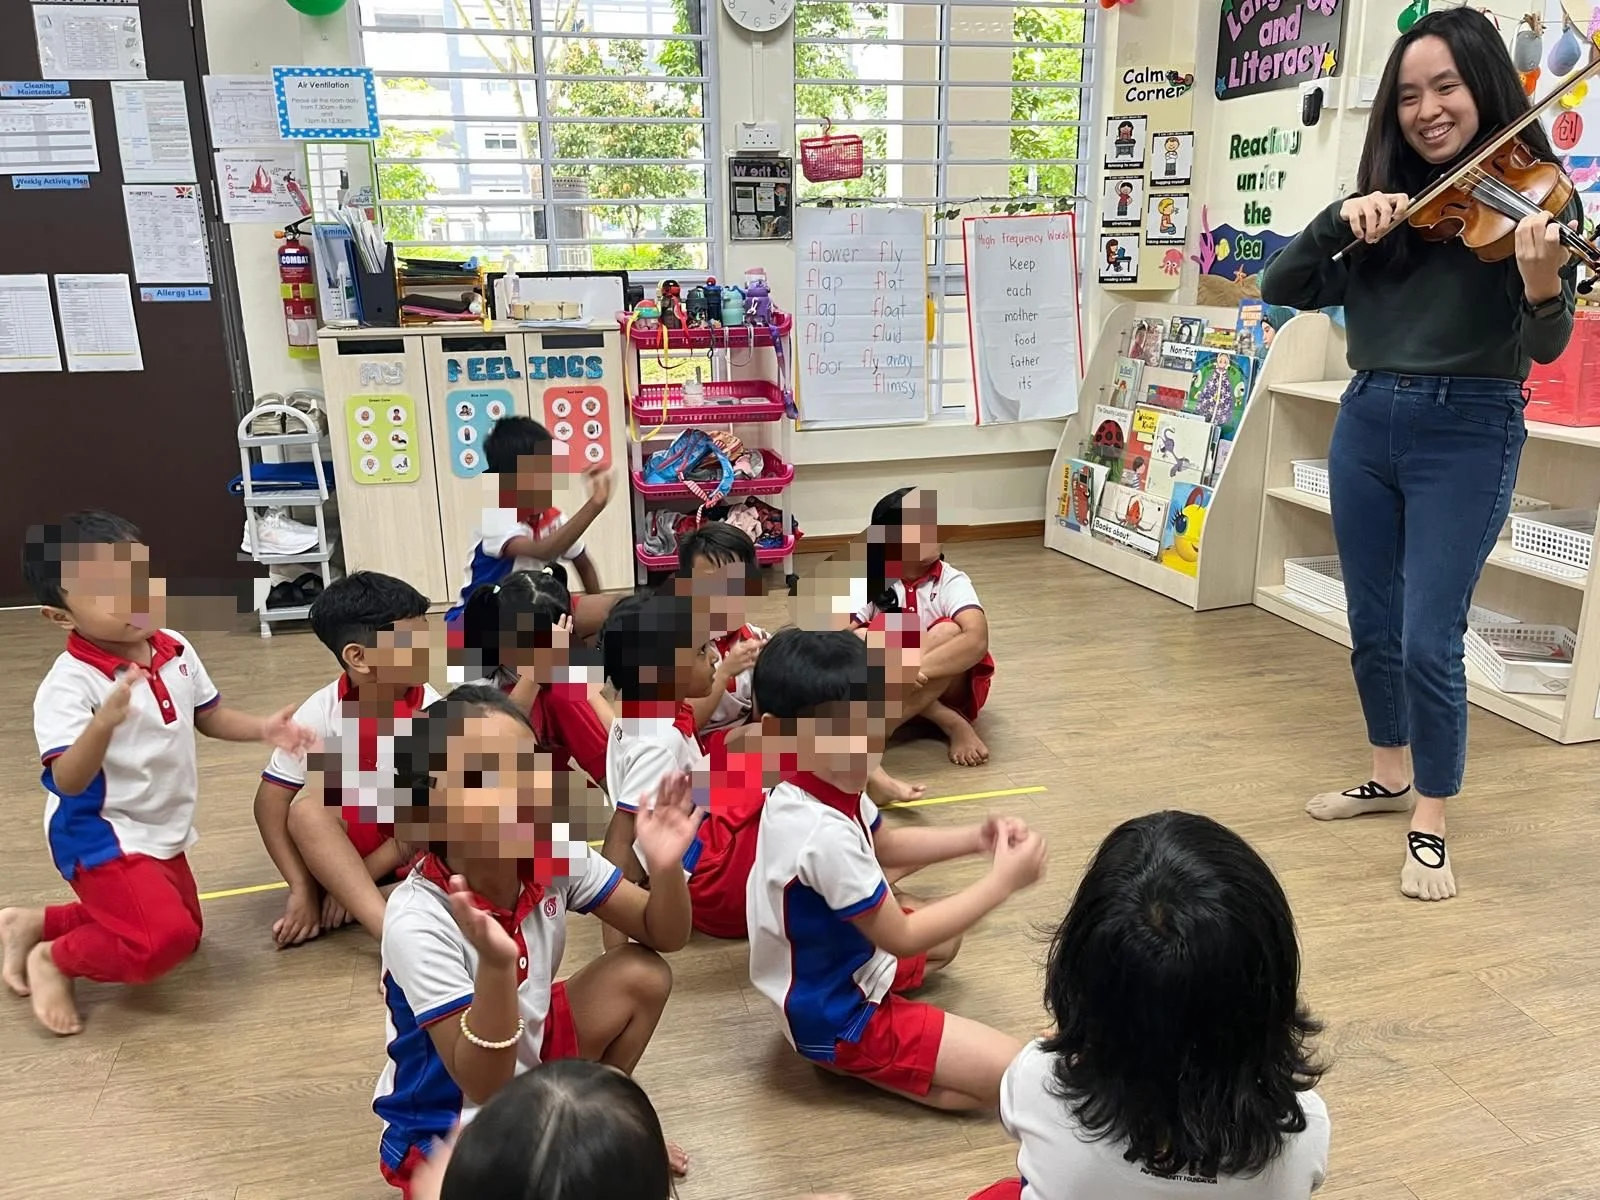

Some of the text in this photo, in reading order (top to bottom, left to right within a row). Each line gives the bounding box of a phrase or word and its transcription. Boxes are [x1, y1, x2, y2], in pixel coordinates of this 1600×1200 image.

[740, 11, 747, 22] 7
[754, 16, 761, 28] 6
[769, 13, 777, 25] 5
[1258, 4, 1303, 48] and
[1123, 66, 1164, 84] Calm
[1228, 42, 1328, 89] Literacy
[24, 82, 55, 90] Cleaning
[298, 81, 350, 89] Air Ventilation
[1125, 86, 1185, 102] Corner
[1557, 114, 1578, 144] 创
[16, 177, 88, 187] Weekly Activity Plan
[848, 212, 864, 235] fl
[1244, 200, 1272, 226] the
[808, 240, 860, 263] flower
[979, 233, 996, 250] High
[1001, 232, 1043, 248] Frequency
[1235, 233, 1263, 260] Sea
[281, 255, 309, 265] COMBAT
[879, 239, 903, 274] fly
[806, 268, 843, 297] flap
[873, 266, 905, 292] flat
[1006, 280, 1032, 297] each
[157, 289, 186, 298] Allergy
[804, 293, 837, 327] flag
[871, 294, 907, 321] float
[1004, 305, 1038, 323] mother
[804, 322, 835, 352] flip
[872, 322, 903, 344] fluid
[1014, 331, 1036, 346] food
[807, 351, 842, 376] floor
[861, 347, 879, 375] fly
[1010, 354, 1040, 369] father
[873, 372, 917, 400] flimsy
[1095, 519, 1130, 540] Books about
